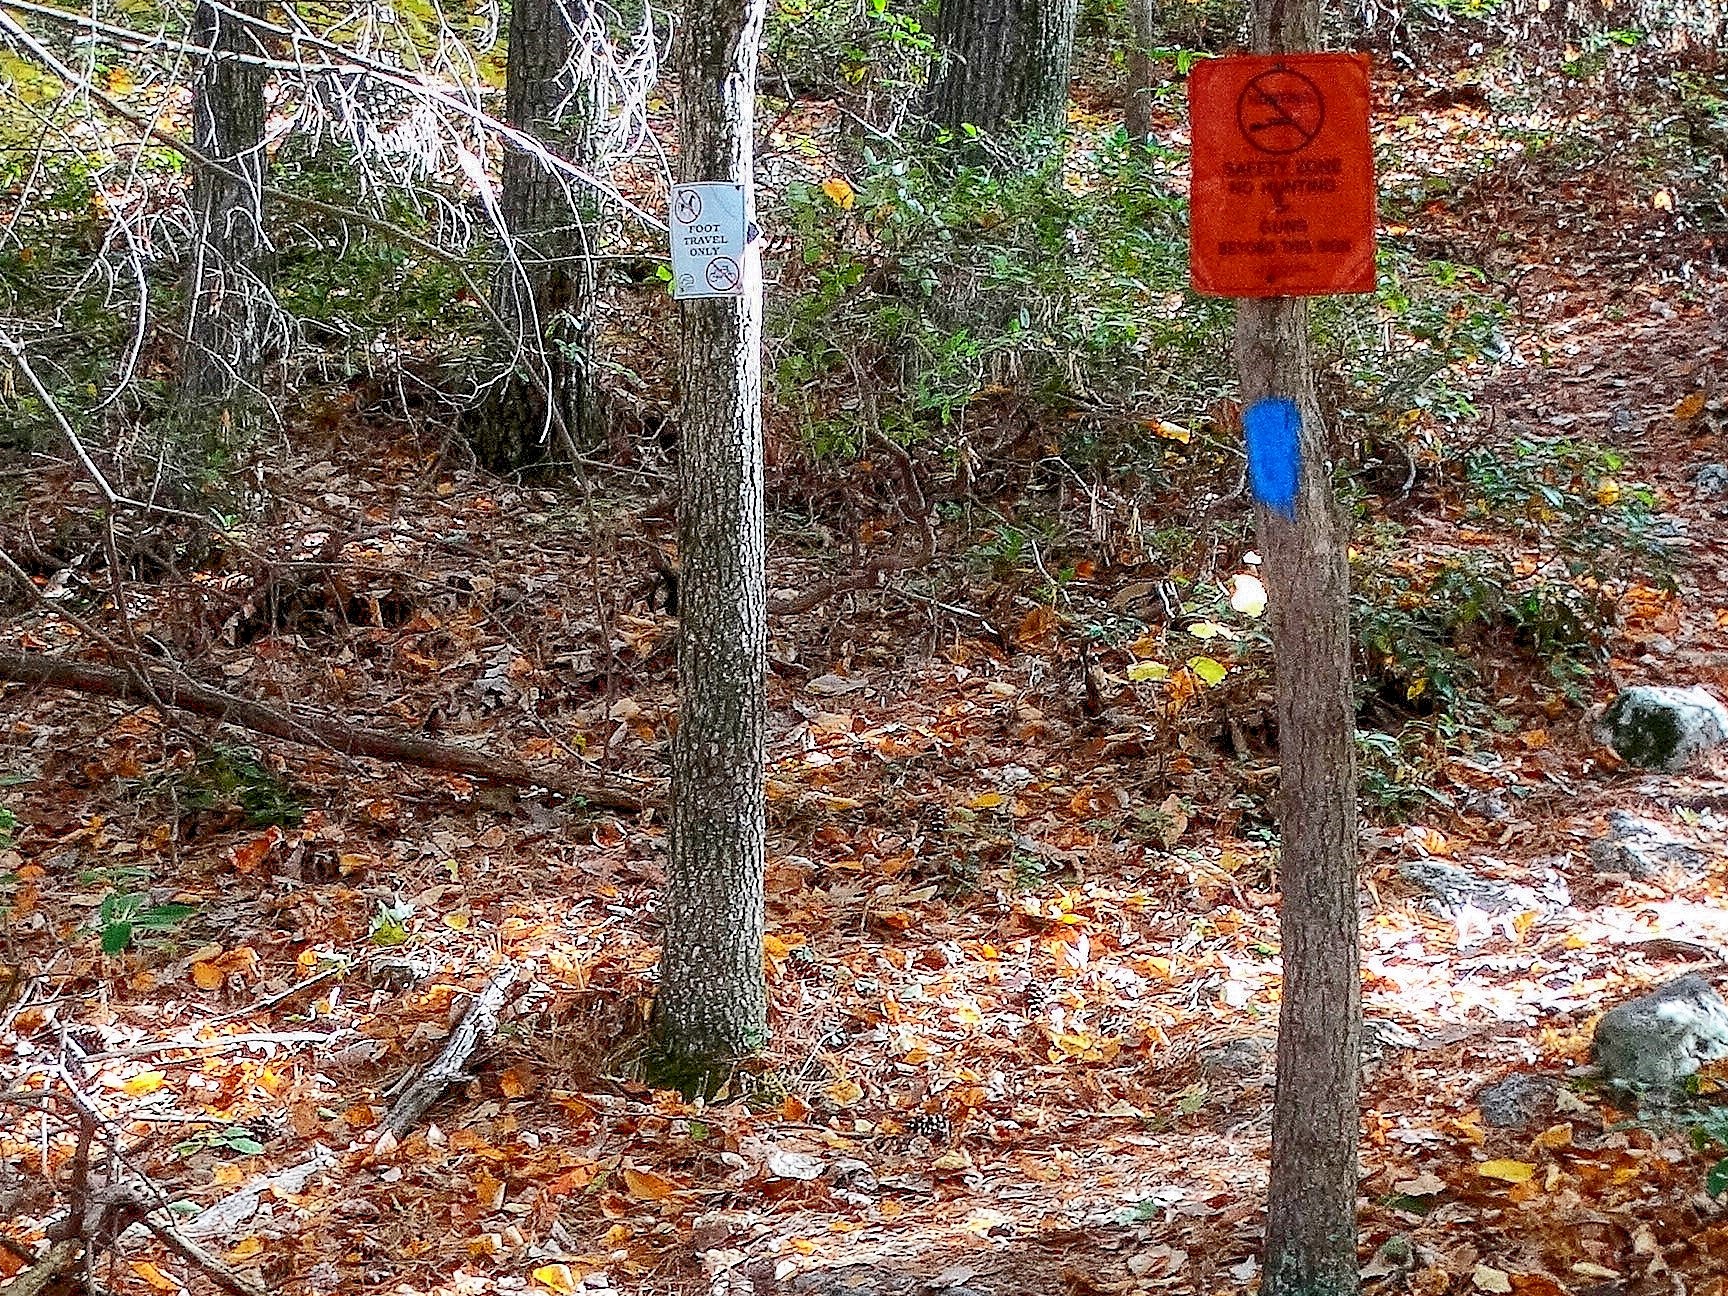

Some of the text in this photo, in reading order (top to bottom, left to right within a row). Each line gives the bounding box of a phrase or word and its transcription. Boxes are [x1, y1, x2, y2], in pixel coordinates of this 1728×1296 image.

[1229, 180, 1254, 194] NO
[689, 224, 721, 234] FOOT
[684, 235, 728, 245] TRAVEL
[690, 246, 721, 256] ONLY
